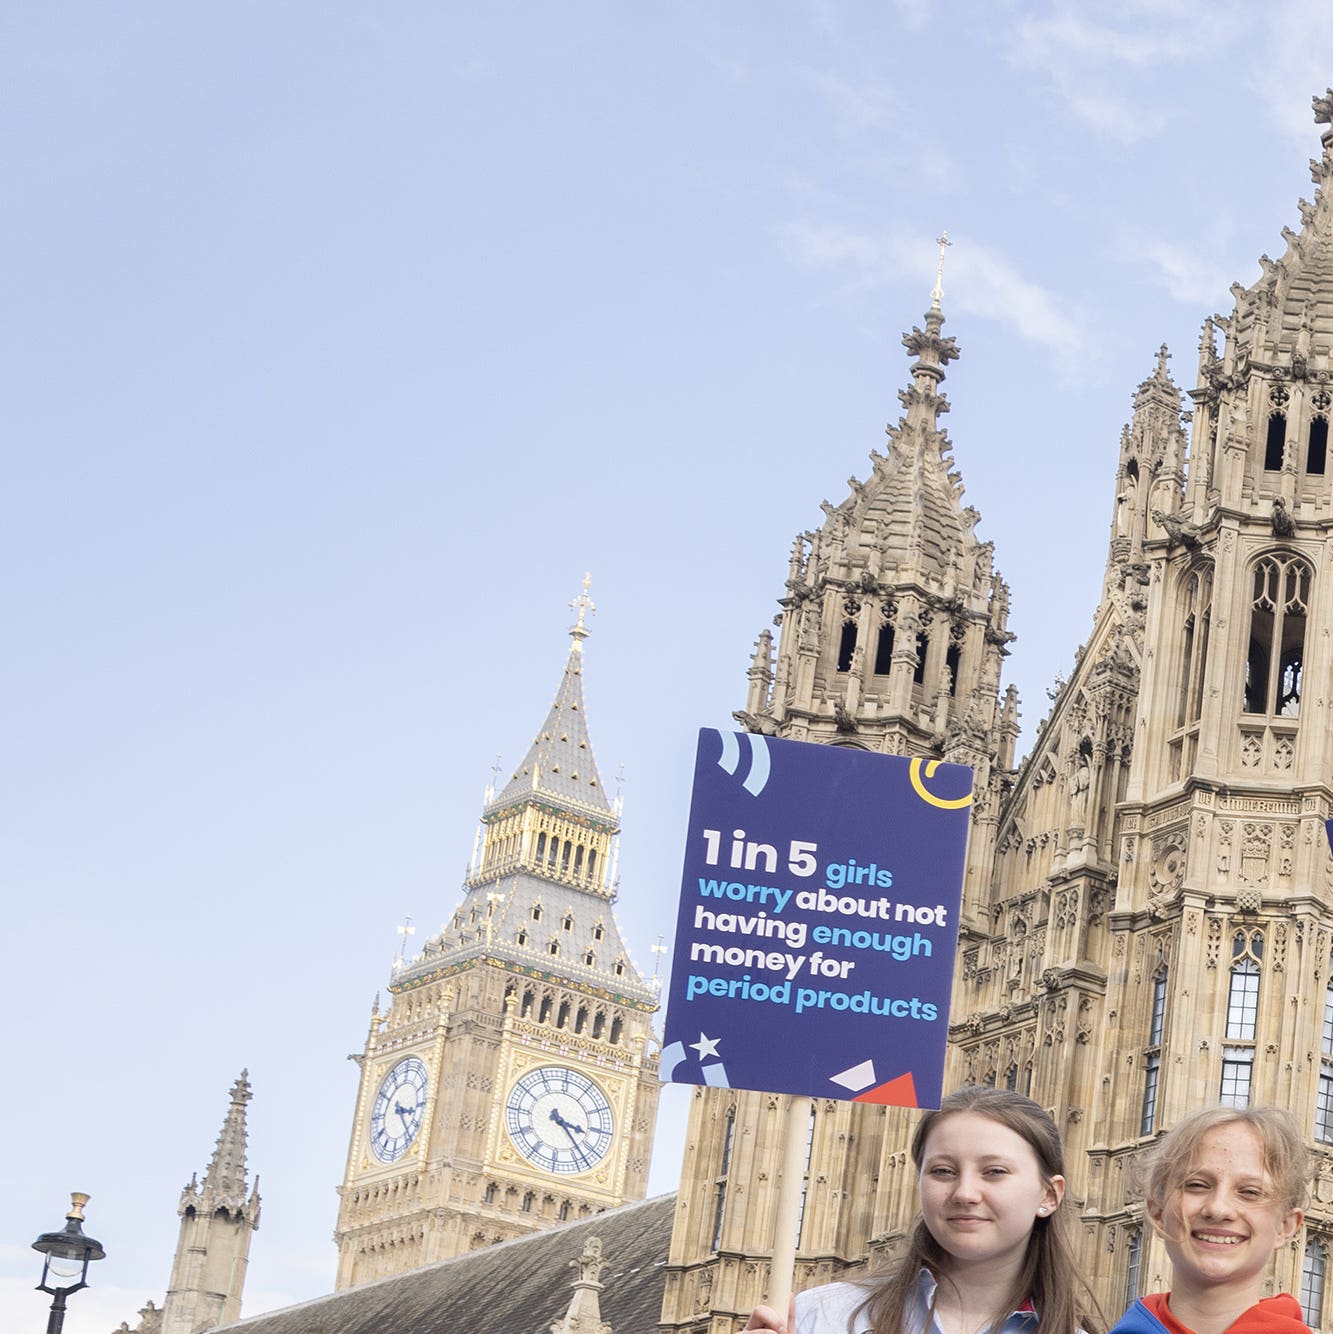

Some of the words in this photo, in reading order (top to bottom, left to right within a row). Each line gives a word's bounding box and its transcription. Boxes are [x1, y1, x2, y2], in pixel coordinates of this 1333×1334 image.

[702, 829, 721, 865] 1
[730, 829, 778, 873] in
[788, 840, 817, 877] 5
[825, 859, 893, 889] girls
[698, 877, 792, 914] worry
[796, 888, 890, 920] about
[895, 899, 947, 927] not
[694, 905, 807, 949] having
[812, 924, 933, 961] enough
[690, 941, 806, 981] money
[809, 952, 855, 980] for
[686, 973, 791, 1004] period
[795, 985, 938, 1022] products
